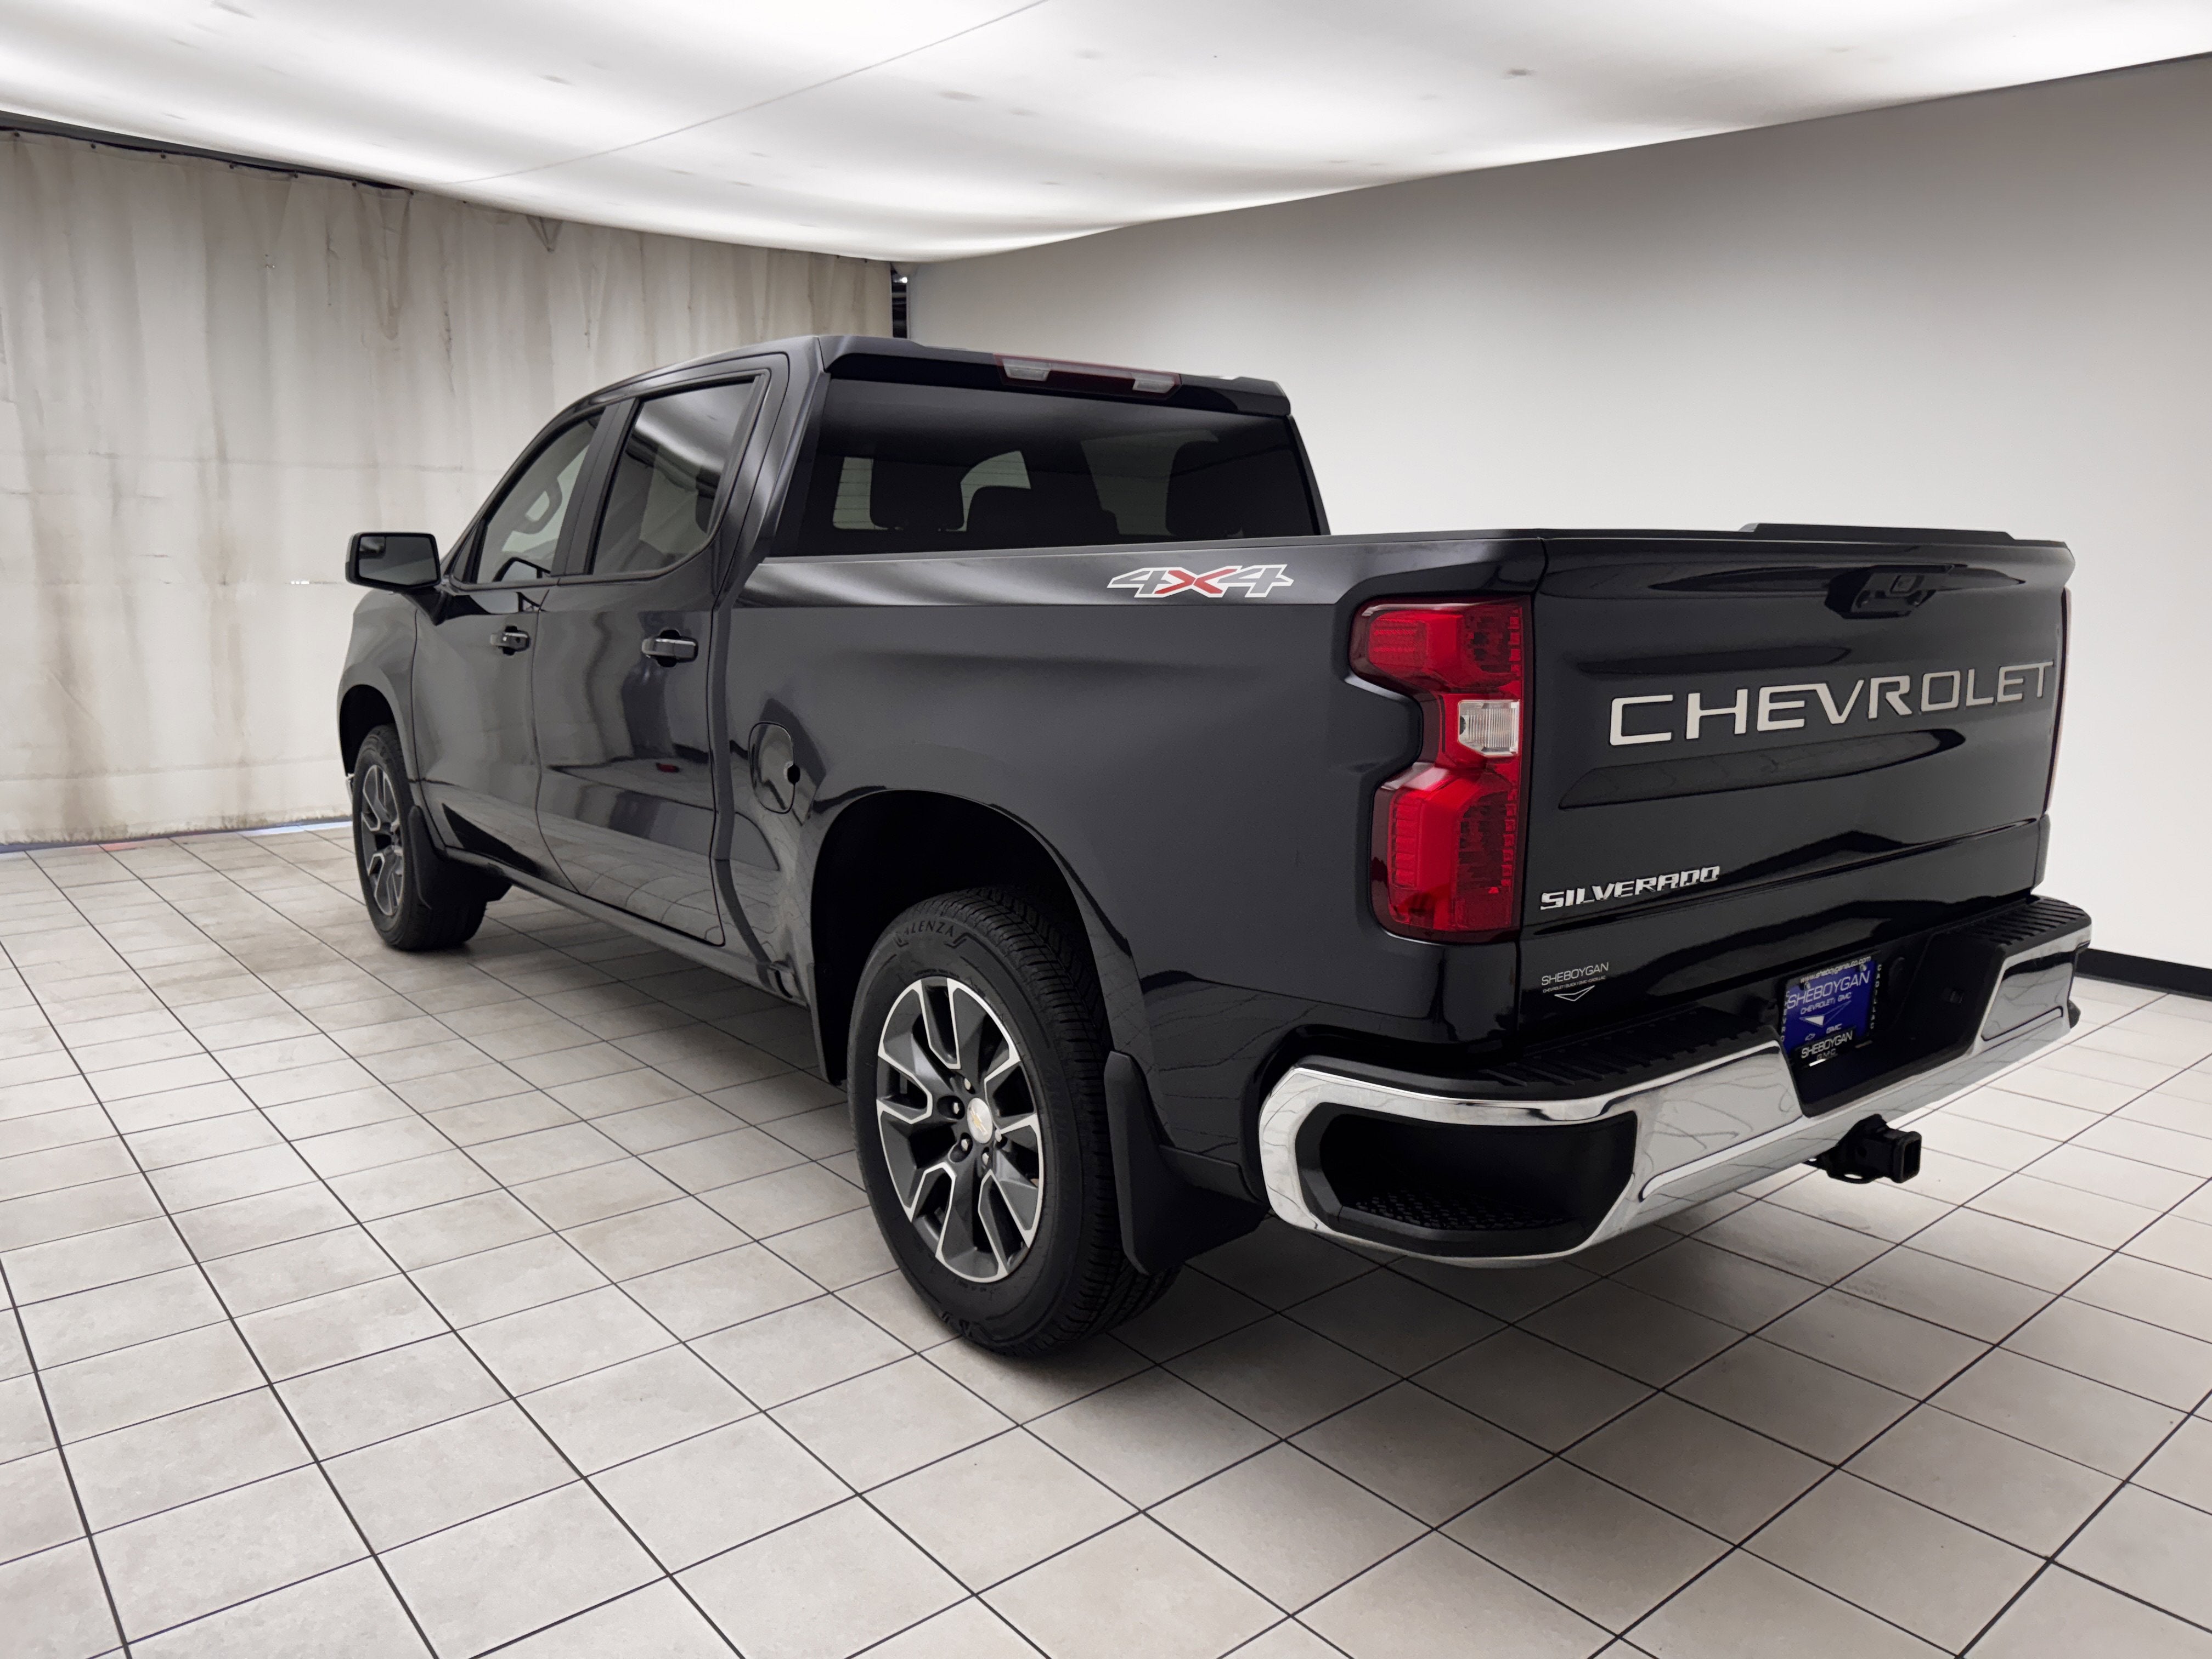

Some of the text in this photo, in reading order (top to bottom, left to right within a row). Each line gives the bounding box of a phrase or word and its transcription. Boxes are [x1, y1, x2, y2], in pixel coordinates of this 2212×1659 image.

[1609, 661, 2054, 746] CHEVROLET
[1540, 865, 1720, 910] SILVERADO
[1541, 961, 1609, 986] SHEBOYGAN
[1787, 970, 1871, 1010] SHEBOYGAN
[1781, 990, 1790, 1042] CHEVRO
[1800, 991, 1852, 1015] CHEVROLET GMC
[1801, 1030, 1853, 1059] SHEBOYGAN
[1826, 1023, 1843, 1034] GMC
